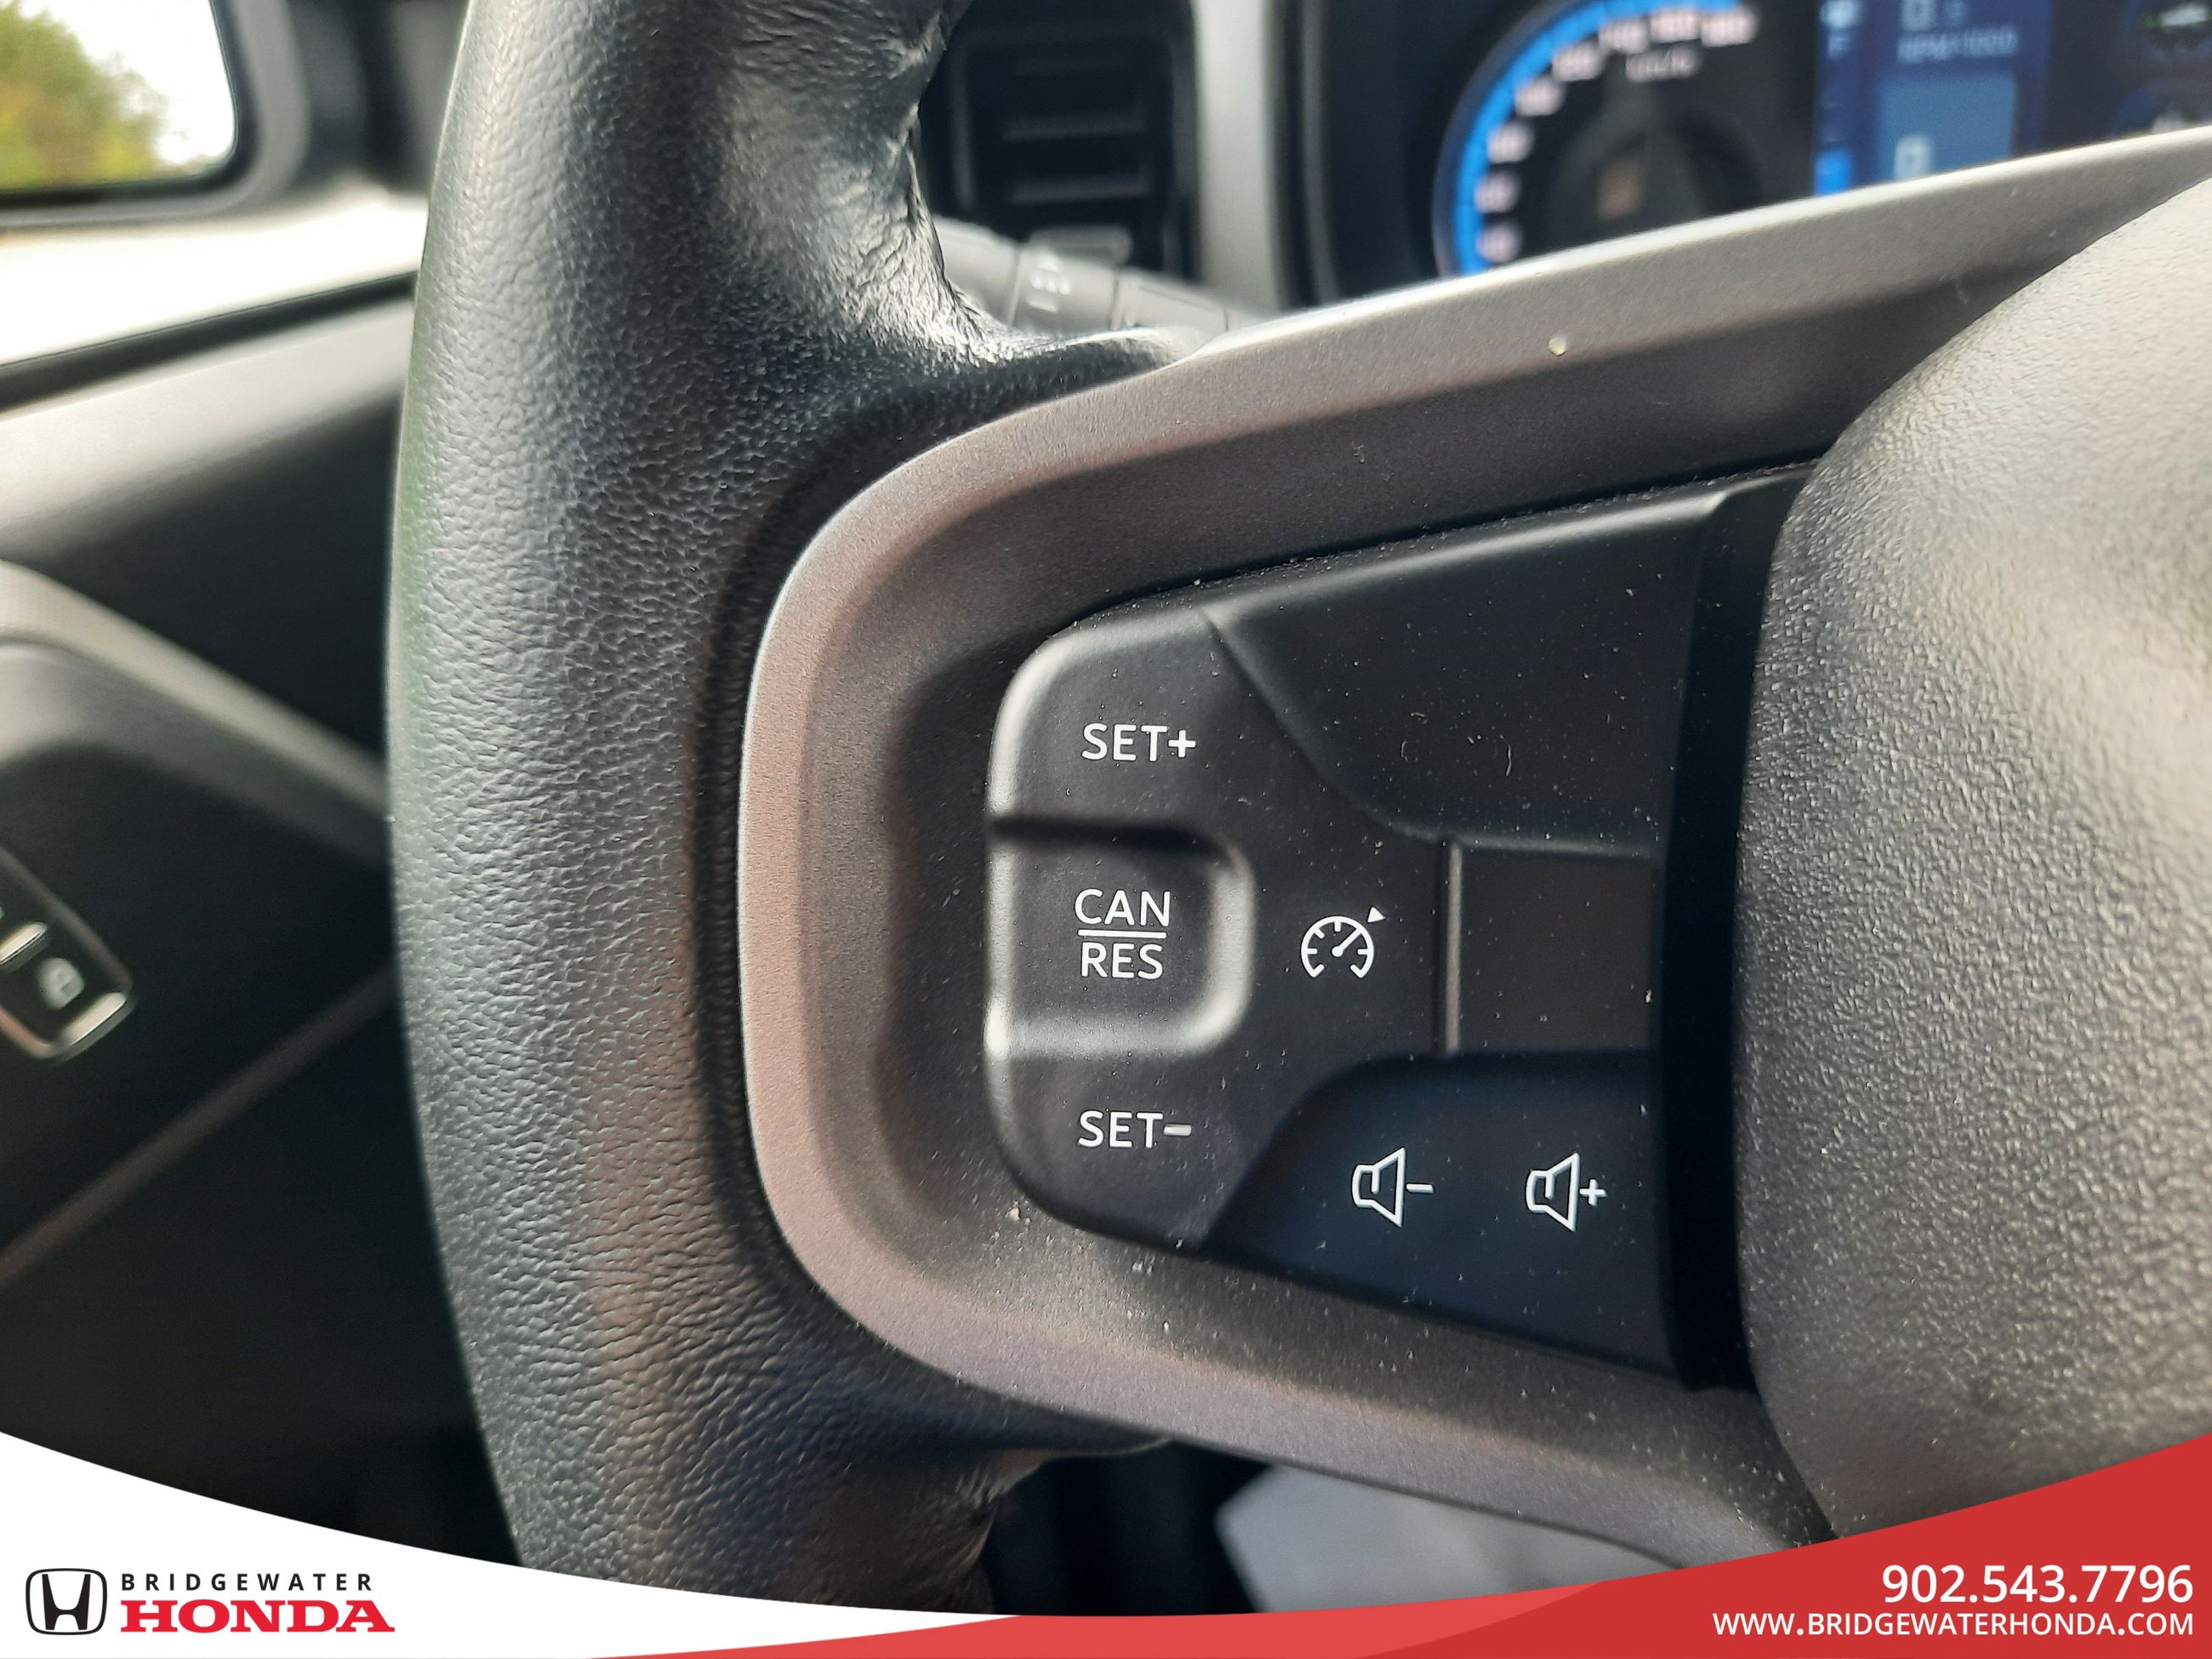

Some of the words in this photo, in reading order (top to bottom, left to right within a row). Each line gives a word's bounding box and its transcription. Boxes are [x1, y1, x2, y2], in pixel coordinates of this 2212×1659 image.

[1081, 722, 1196, 761] SET+
[1075, 888, 1171, 927] CAN
[1080, 942, 1164, 980] RES
